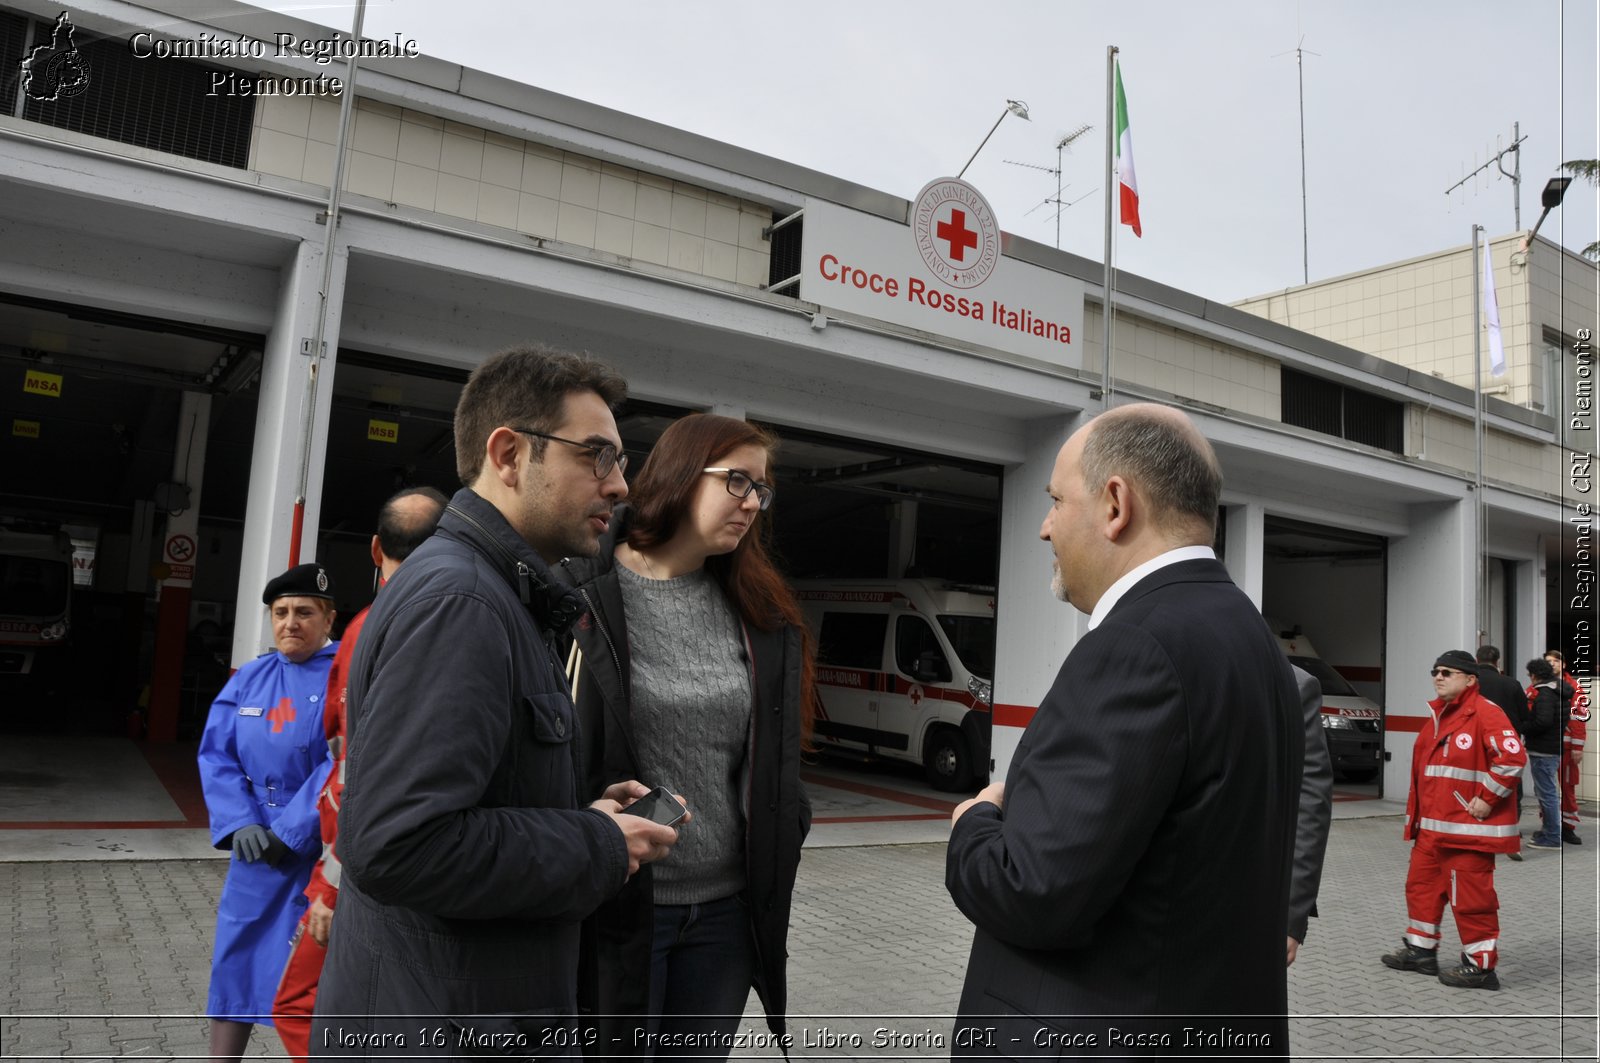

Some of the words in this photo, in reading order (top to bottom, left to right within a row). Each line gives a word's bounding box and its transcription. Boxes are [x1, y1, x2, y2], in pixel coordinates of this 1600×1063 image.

[930, 191, 943, 204] DI
[942, 186, 982, 216] GINEVRA
[918, 199, 950, 280] CONVENZIONE
[979, 231, 996, 276] AGOSTO
[819, 254, 899, 298] Croce
[907, 276, 984, 321] Rossa
[991, 300, 1071, 345] Italiana
[26, 378, 59, 393] MSA
[369, 426, 395, 438] MSB
[843, 592, 885, 602] AVANZATO
